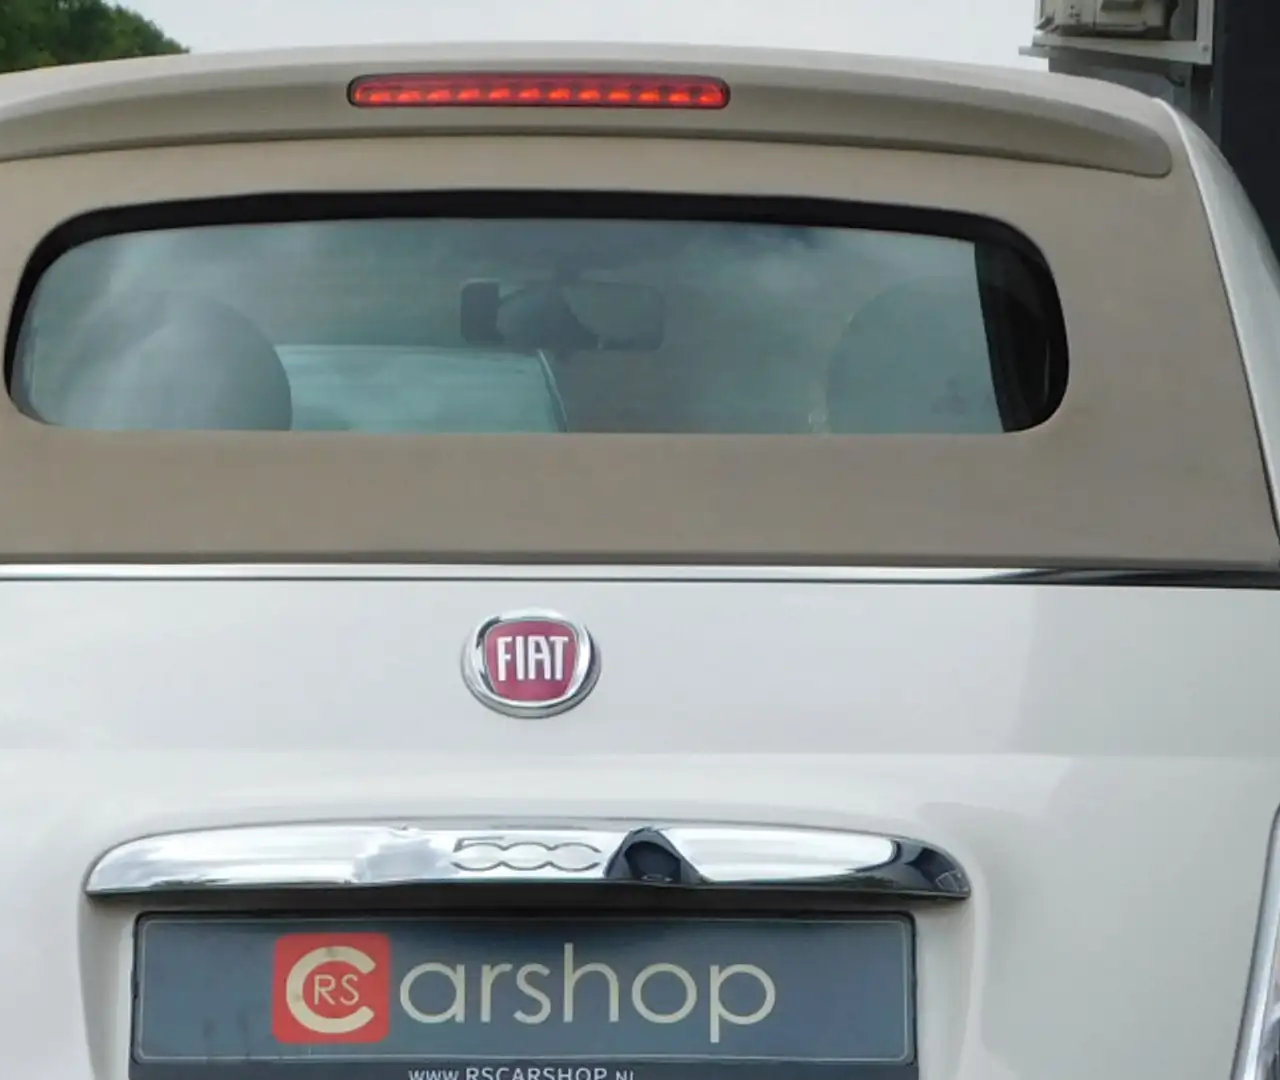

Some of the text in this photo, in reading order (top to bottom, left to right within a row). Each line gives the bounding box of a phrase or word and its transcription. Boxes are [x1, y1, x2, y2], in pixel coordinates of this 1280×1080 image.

[496, 635, 568, 681] FIAT
[451, 837, 602, 872] 500
[286, 942, 776, 1043] Carshop
[314, 974, 360, 1006] RS
